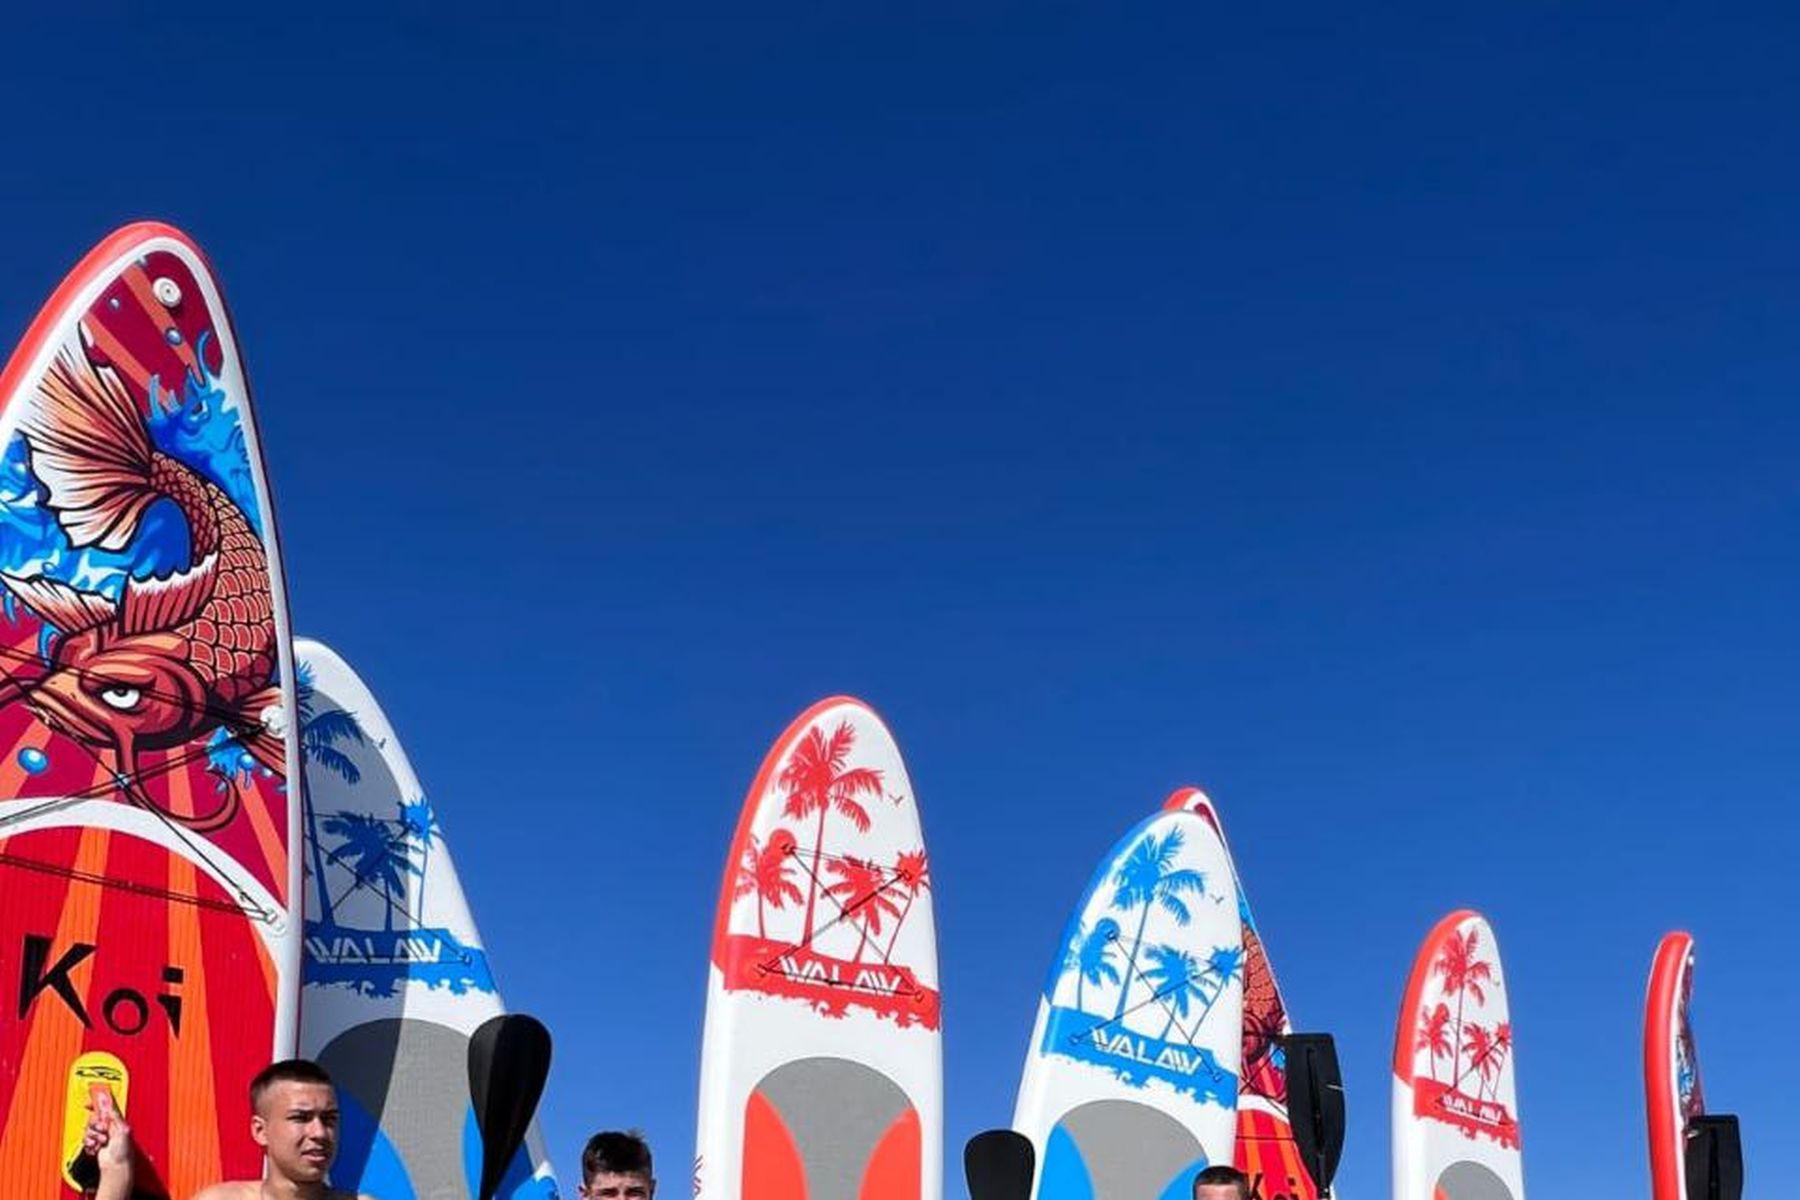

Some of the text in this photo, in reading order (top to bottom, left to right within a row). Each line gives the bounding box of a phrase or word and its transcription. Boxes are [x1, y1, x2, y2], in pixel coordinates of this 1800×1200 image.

[18, 932, 184, 1040] Koi
[779, 956, 901, 997] WALAW
[1092, 1028, 1202, 1076] WALAW
